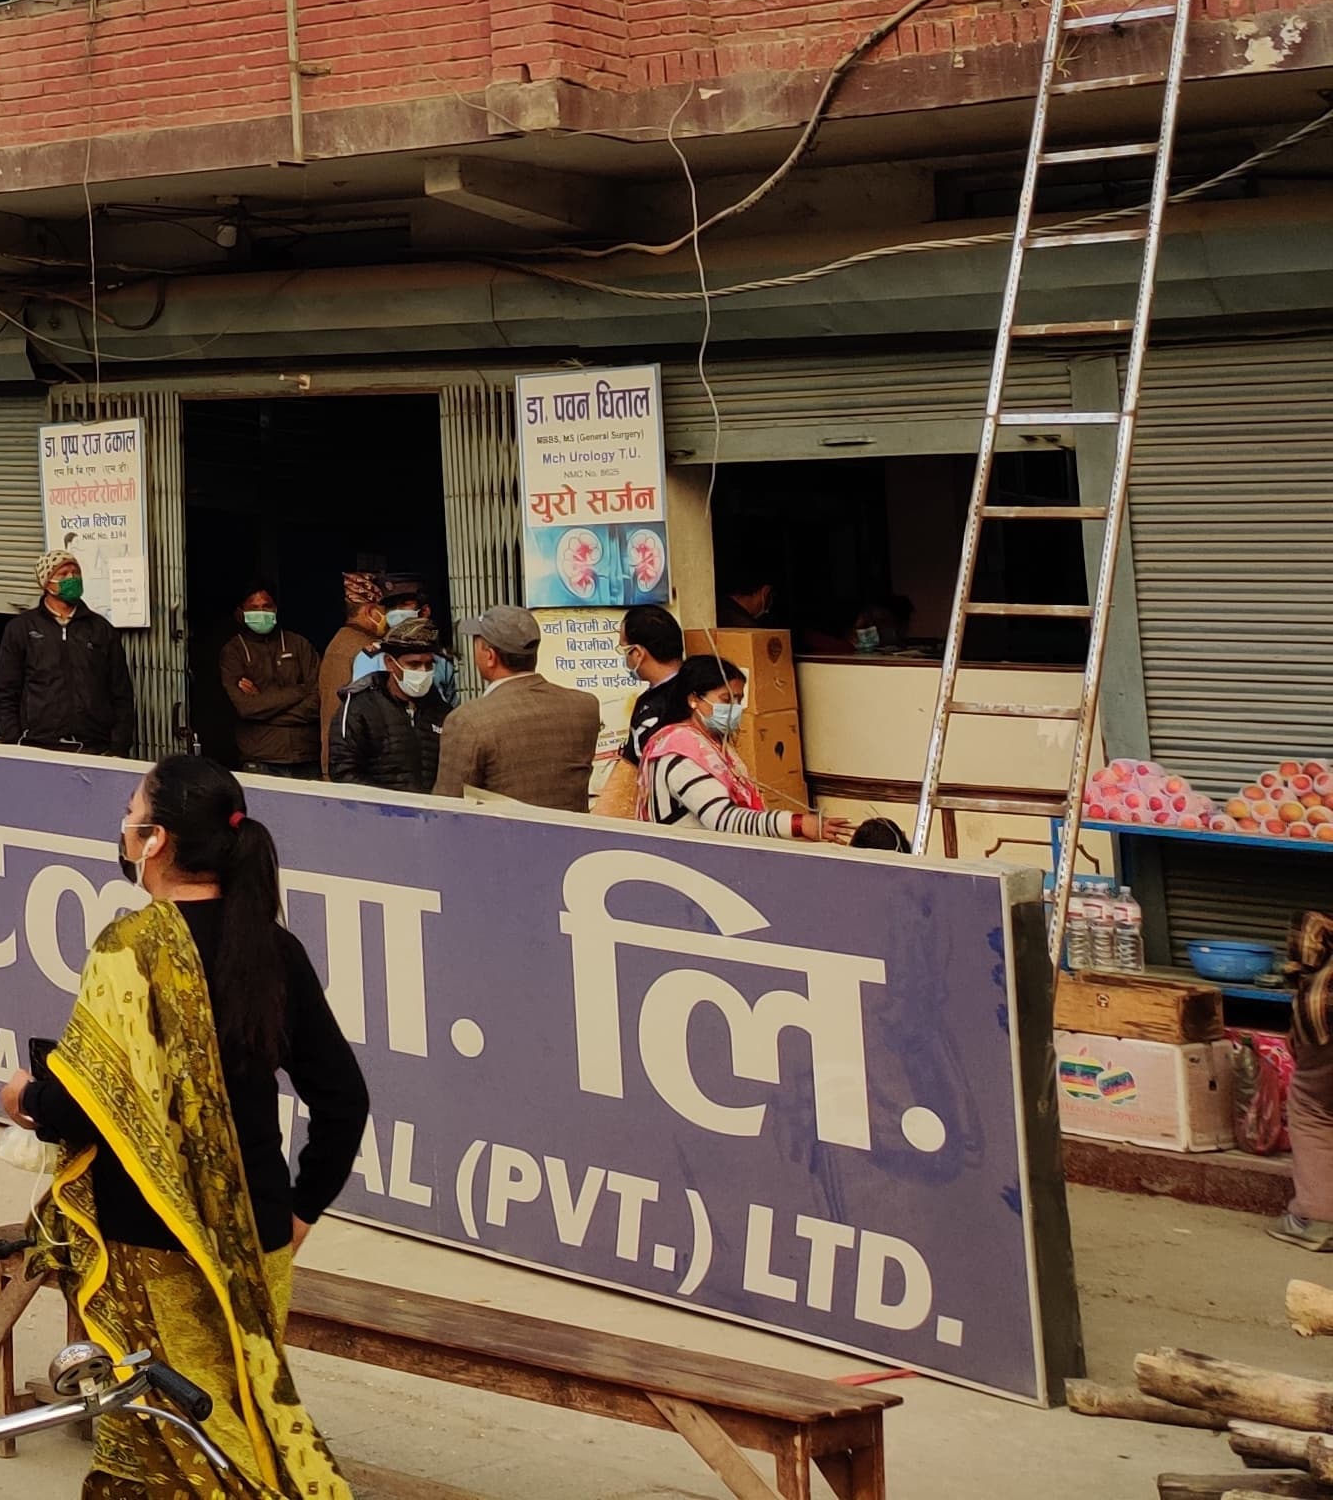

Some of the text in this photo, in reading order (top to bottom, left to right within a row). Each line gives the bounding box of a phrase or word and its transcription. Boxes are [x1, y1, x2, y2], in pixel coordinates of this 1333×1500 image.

[526, 395, 548, 426] डा.
[553, 392, 590, 422] पवन
[82, 433, 101, 456] राज
[563, 433, 575, 443] MS
[576, 430, 609, 444] (General
[611, 429, 645, 443] Surgery)
[542, 448, 641, 466] Mch Urology T.U.
[530, 481, 656, 524] युरो सर्जन
[558, 849, 947, 1154] लि.
[455, 1138, 716, 1297] (PVT.)
[743, 1203, 965, 1351] LTD.
